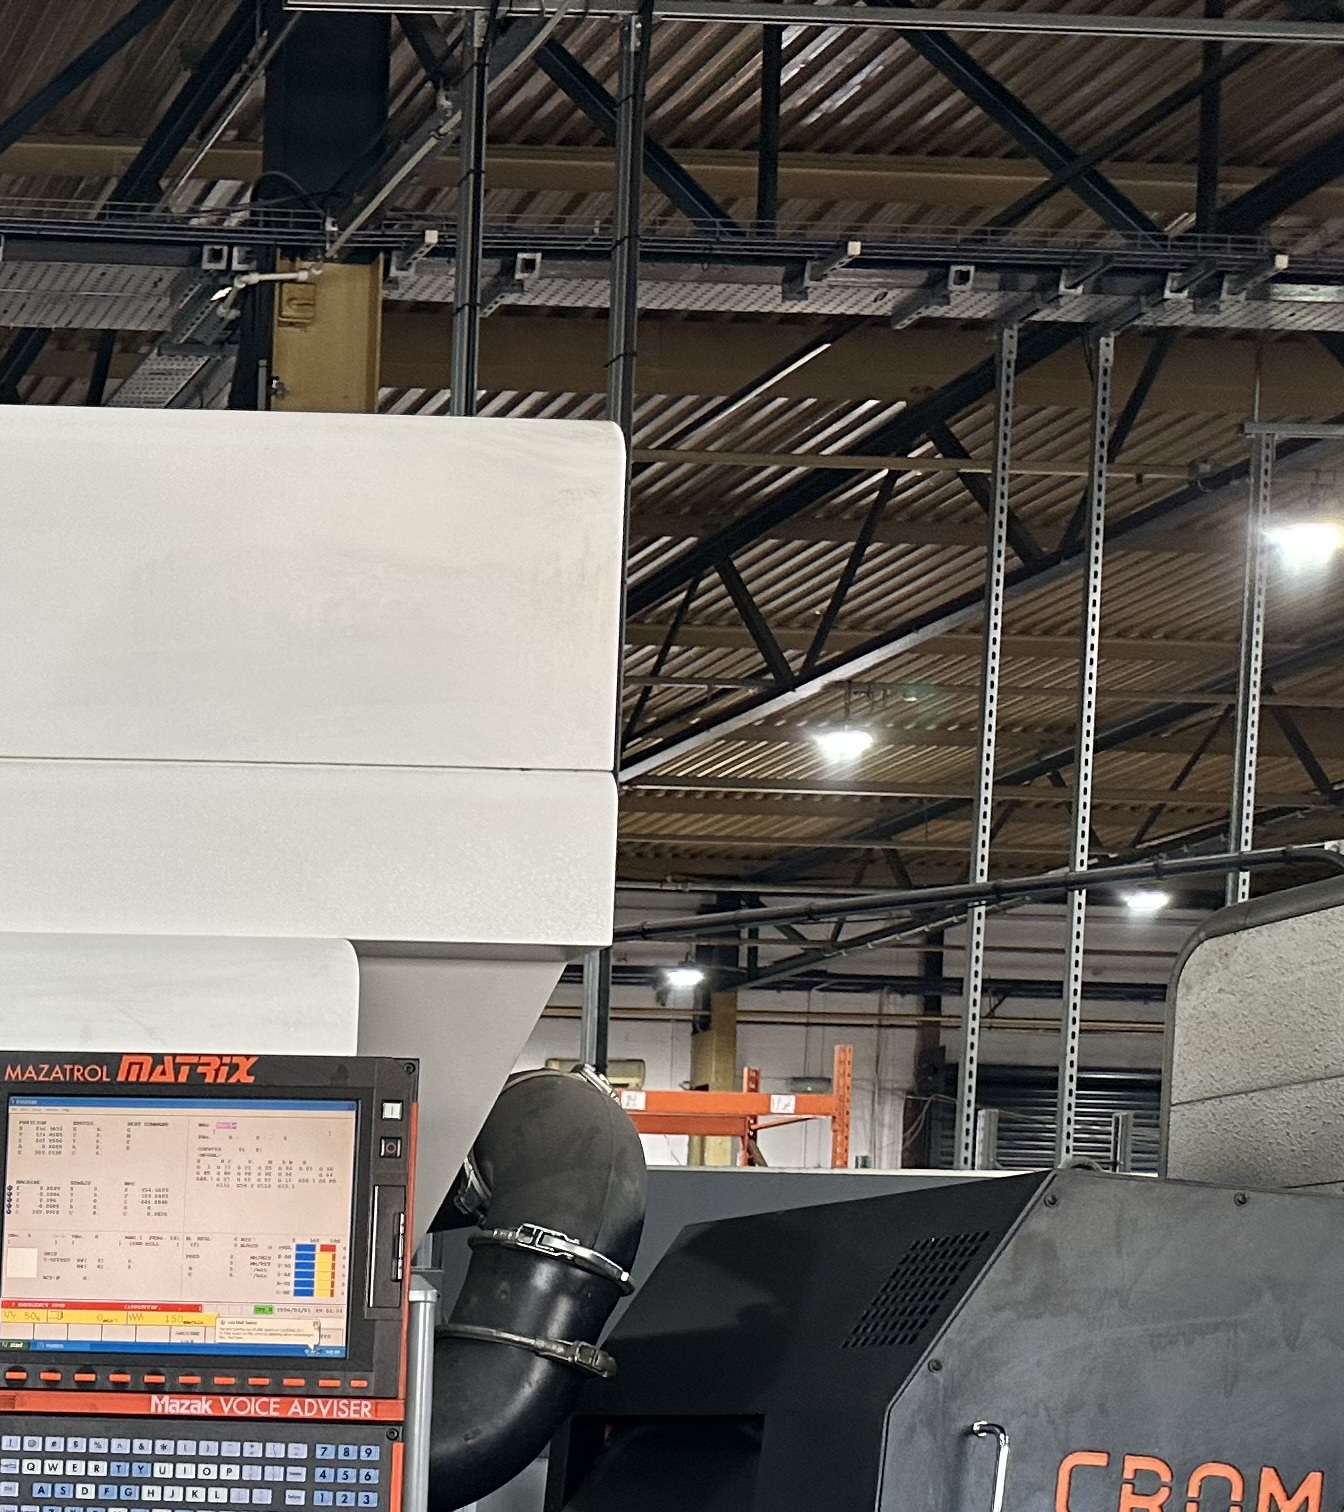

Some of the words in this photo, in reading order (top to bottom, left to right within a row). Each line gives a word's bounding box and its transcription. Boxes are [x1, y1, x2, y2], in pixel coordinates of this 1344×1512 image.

[4, 1064, 111, 1082] MAZATROL
[150, 1395, 214, 1414] Mazak
[220, 1397, 280, 1416] VOICE
[288, 1399, 372, 1418] ADVISER
[321, 1448, 328, 1456] 7
[343, 1448, 349, 1457] 8
[365, 1448, 372, 1457] 9
[27, 1463, 35, 1471] Q
[48, 1463, 58, 1472] W
[72, 1464, 77, 1472] E
[93, 1465, 100, 1473] R
[116, 1465, 121, 1473] T
[137, 1465, 144, 1473] Y
[159, 1466, 166, 1475] U
[226, 1468, 233, 1476] P
[319, 1471, 326, 1479] 4
[342, 1471, 349, 1480] 5
[364, 1471, 371, 1480] 6
[37, 1487, 45, 1495] A
[60, 1487, 66, 1495] S
[82, 1487, 88, 1495] D
[104, 1488, 109, 1496] F
[124, 1488, 132, 1497] G
[147, 1489, 155, 1497] H
[170, 1490, 175, 1498] J
[192, 1490, 199, 1498] K
[320, 1493, 324, 1502] 1
[341, 1494, 348, 1502] 2
[363, 1495, 370, 1504] 3
